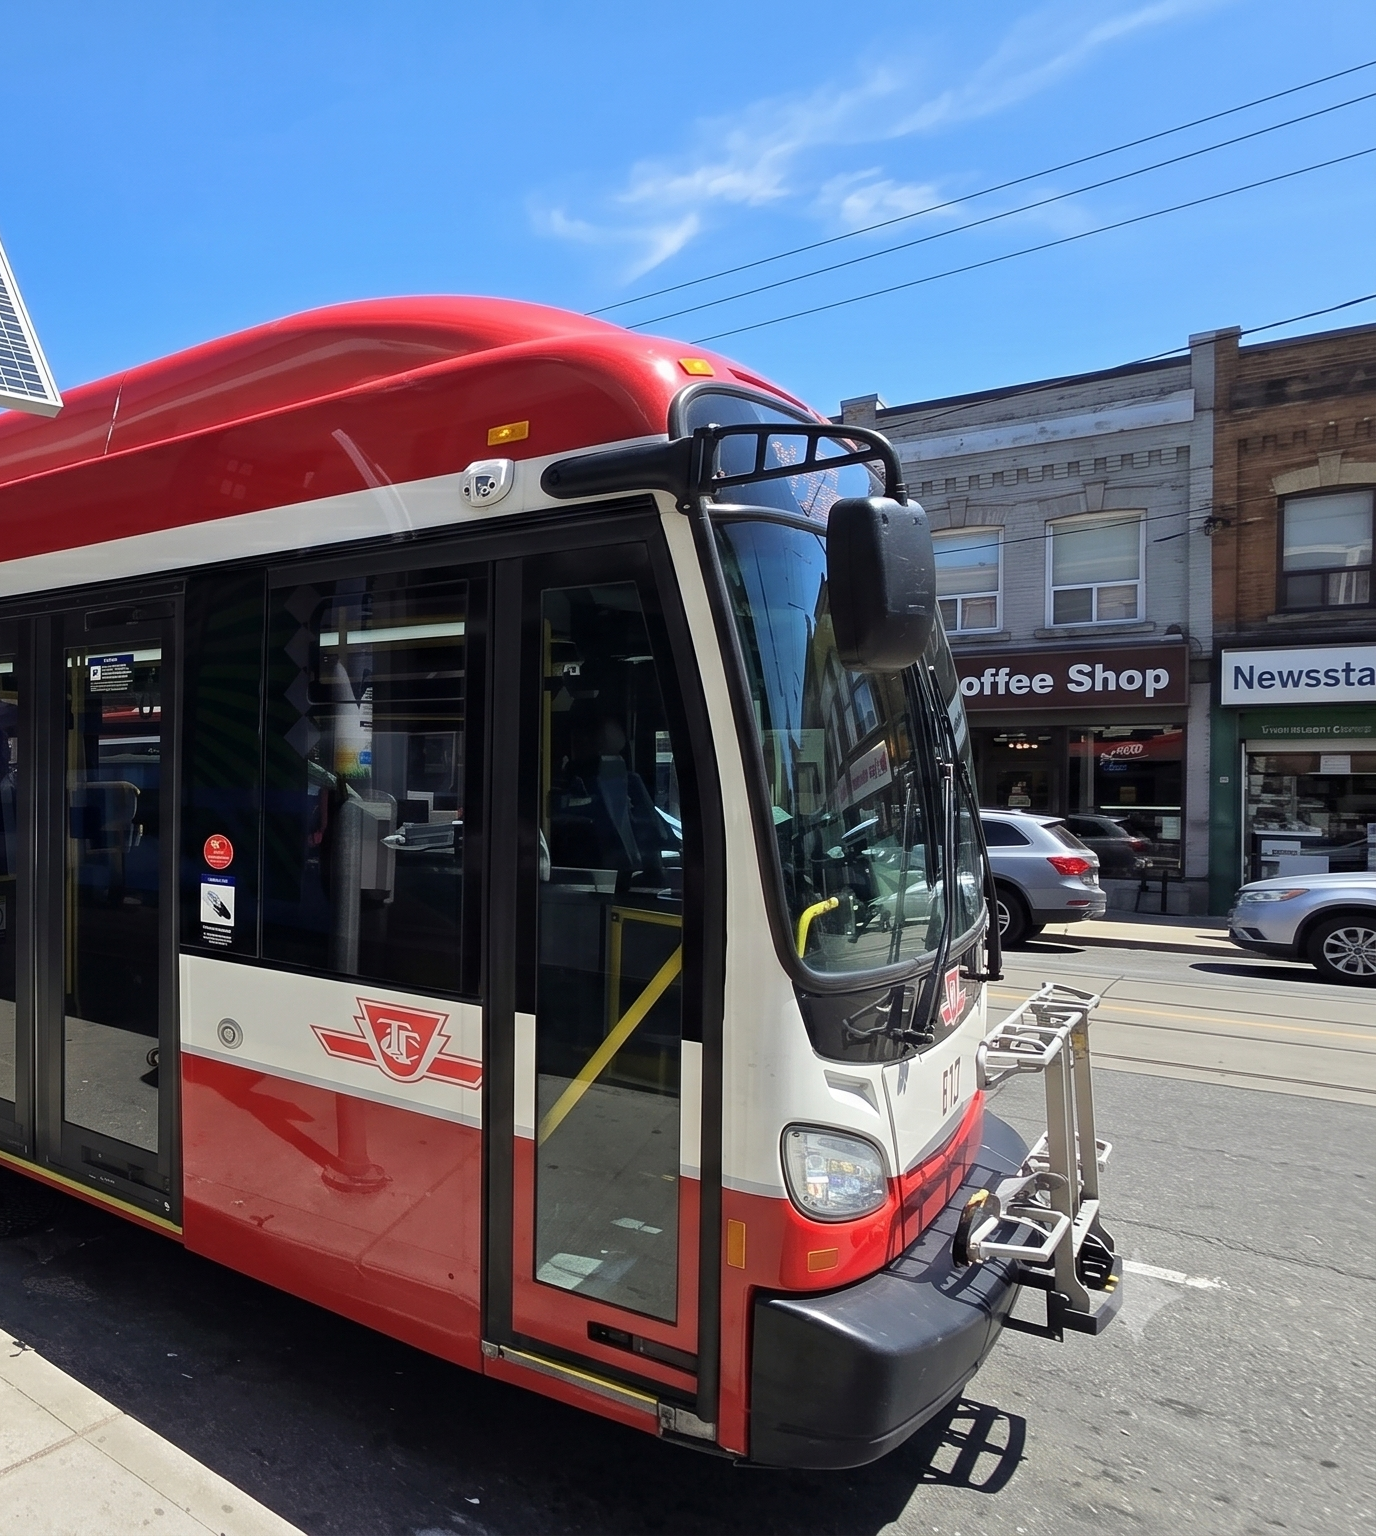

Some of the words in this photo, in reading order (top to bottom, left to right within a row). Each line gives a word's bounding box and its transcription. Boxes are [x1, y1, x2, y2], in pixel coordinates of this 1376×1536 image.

[960, 667, 1054, 697] offee
[1067, 663, 1170, 698] Shop
[1233, 662, 1376, 690] Newssta
